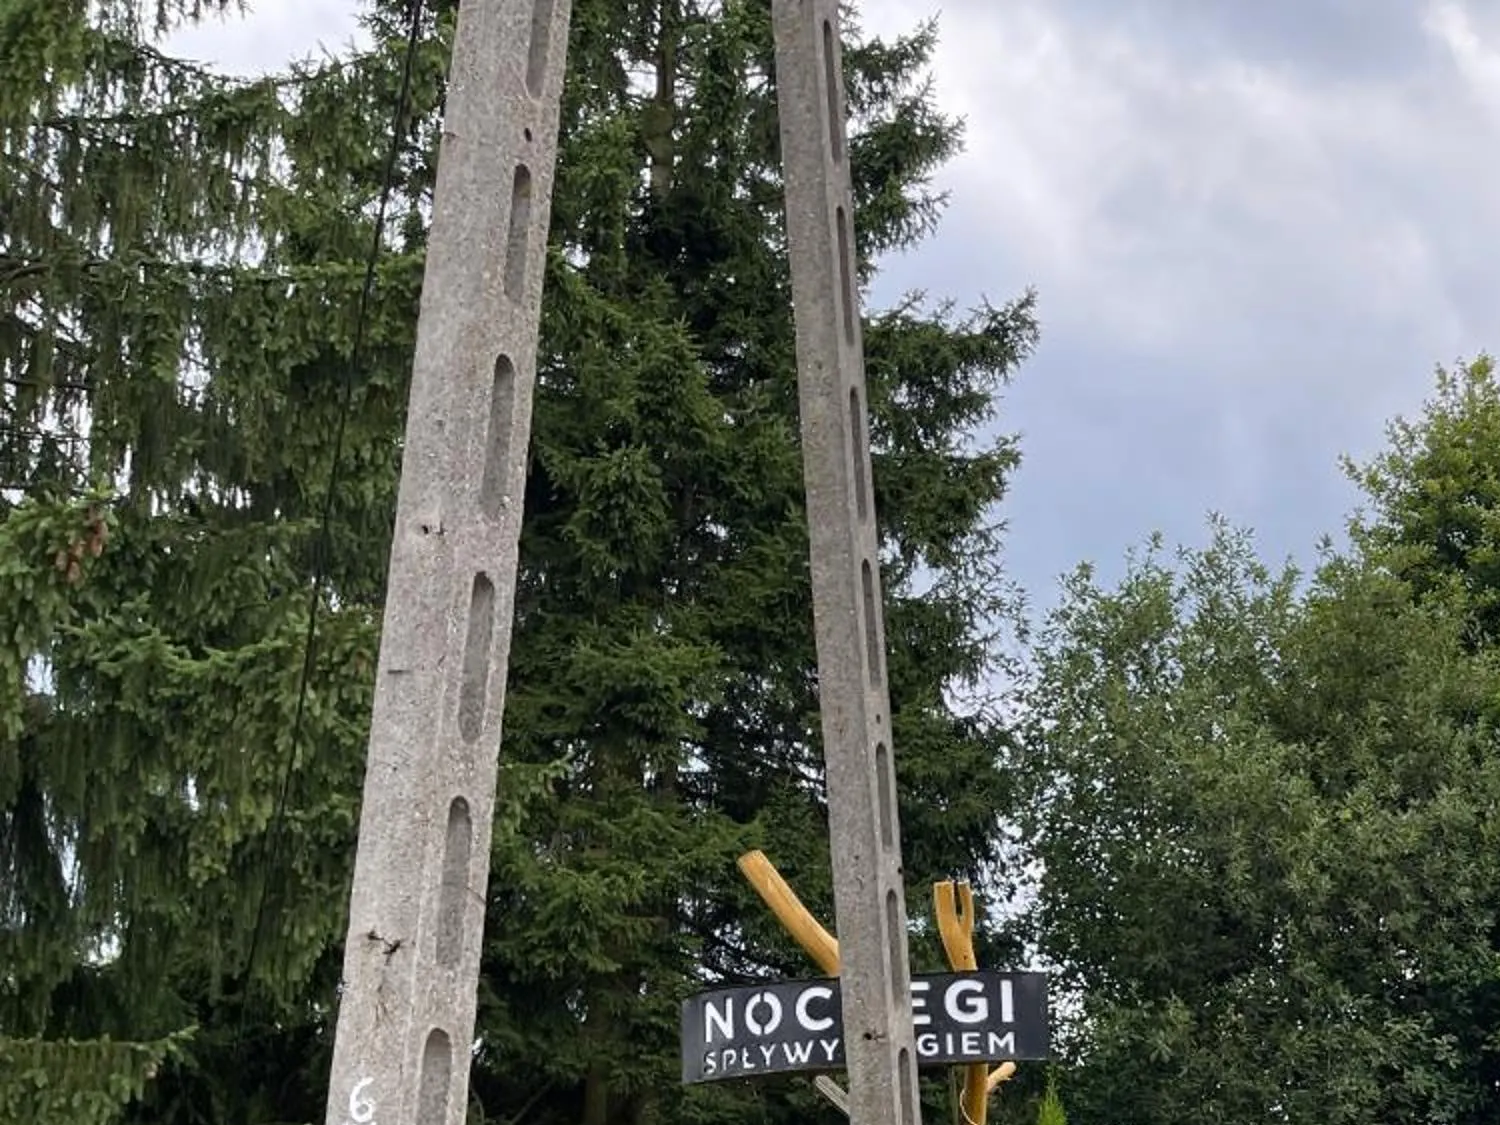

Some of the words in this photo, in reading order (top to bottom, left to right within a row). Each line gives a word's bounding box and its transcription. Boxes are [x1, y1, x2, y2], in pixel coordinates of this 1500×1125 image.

[705, 980, 1014, 1043] NOCEGI
[704, 1038, 839, 1074] SPŁYWY
[917, 1032, 1015, 1056] GIEM
[350, 1077, 375, 1122] 6
